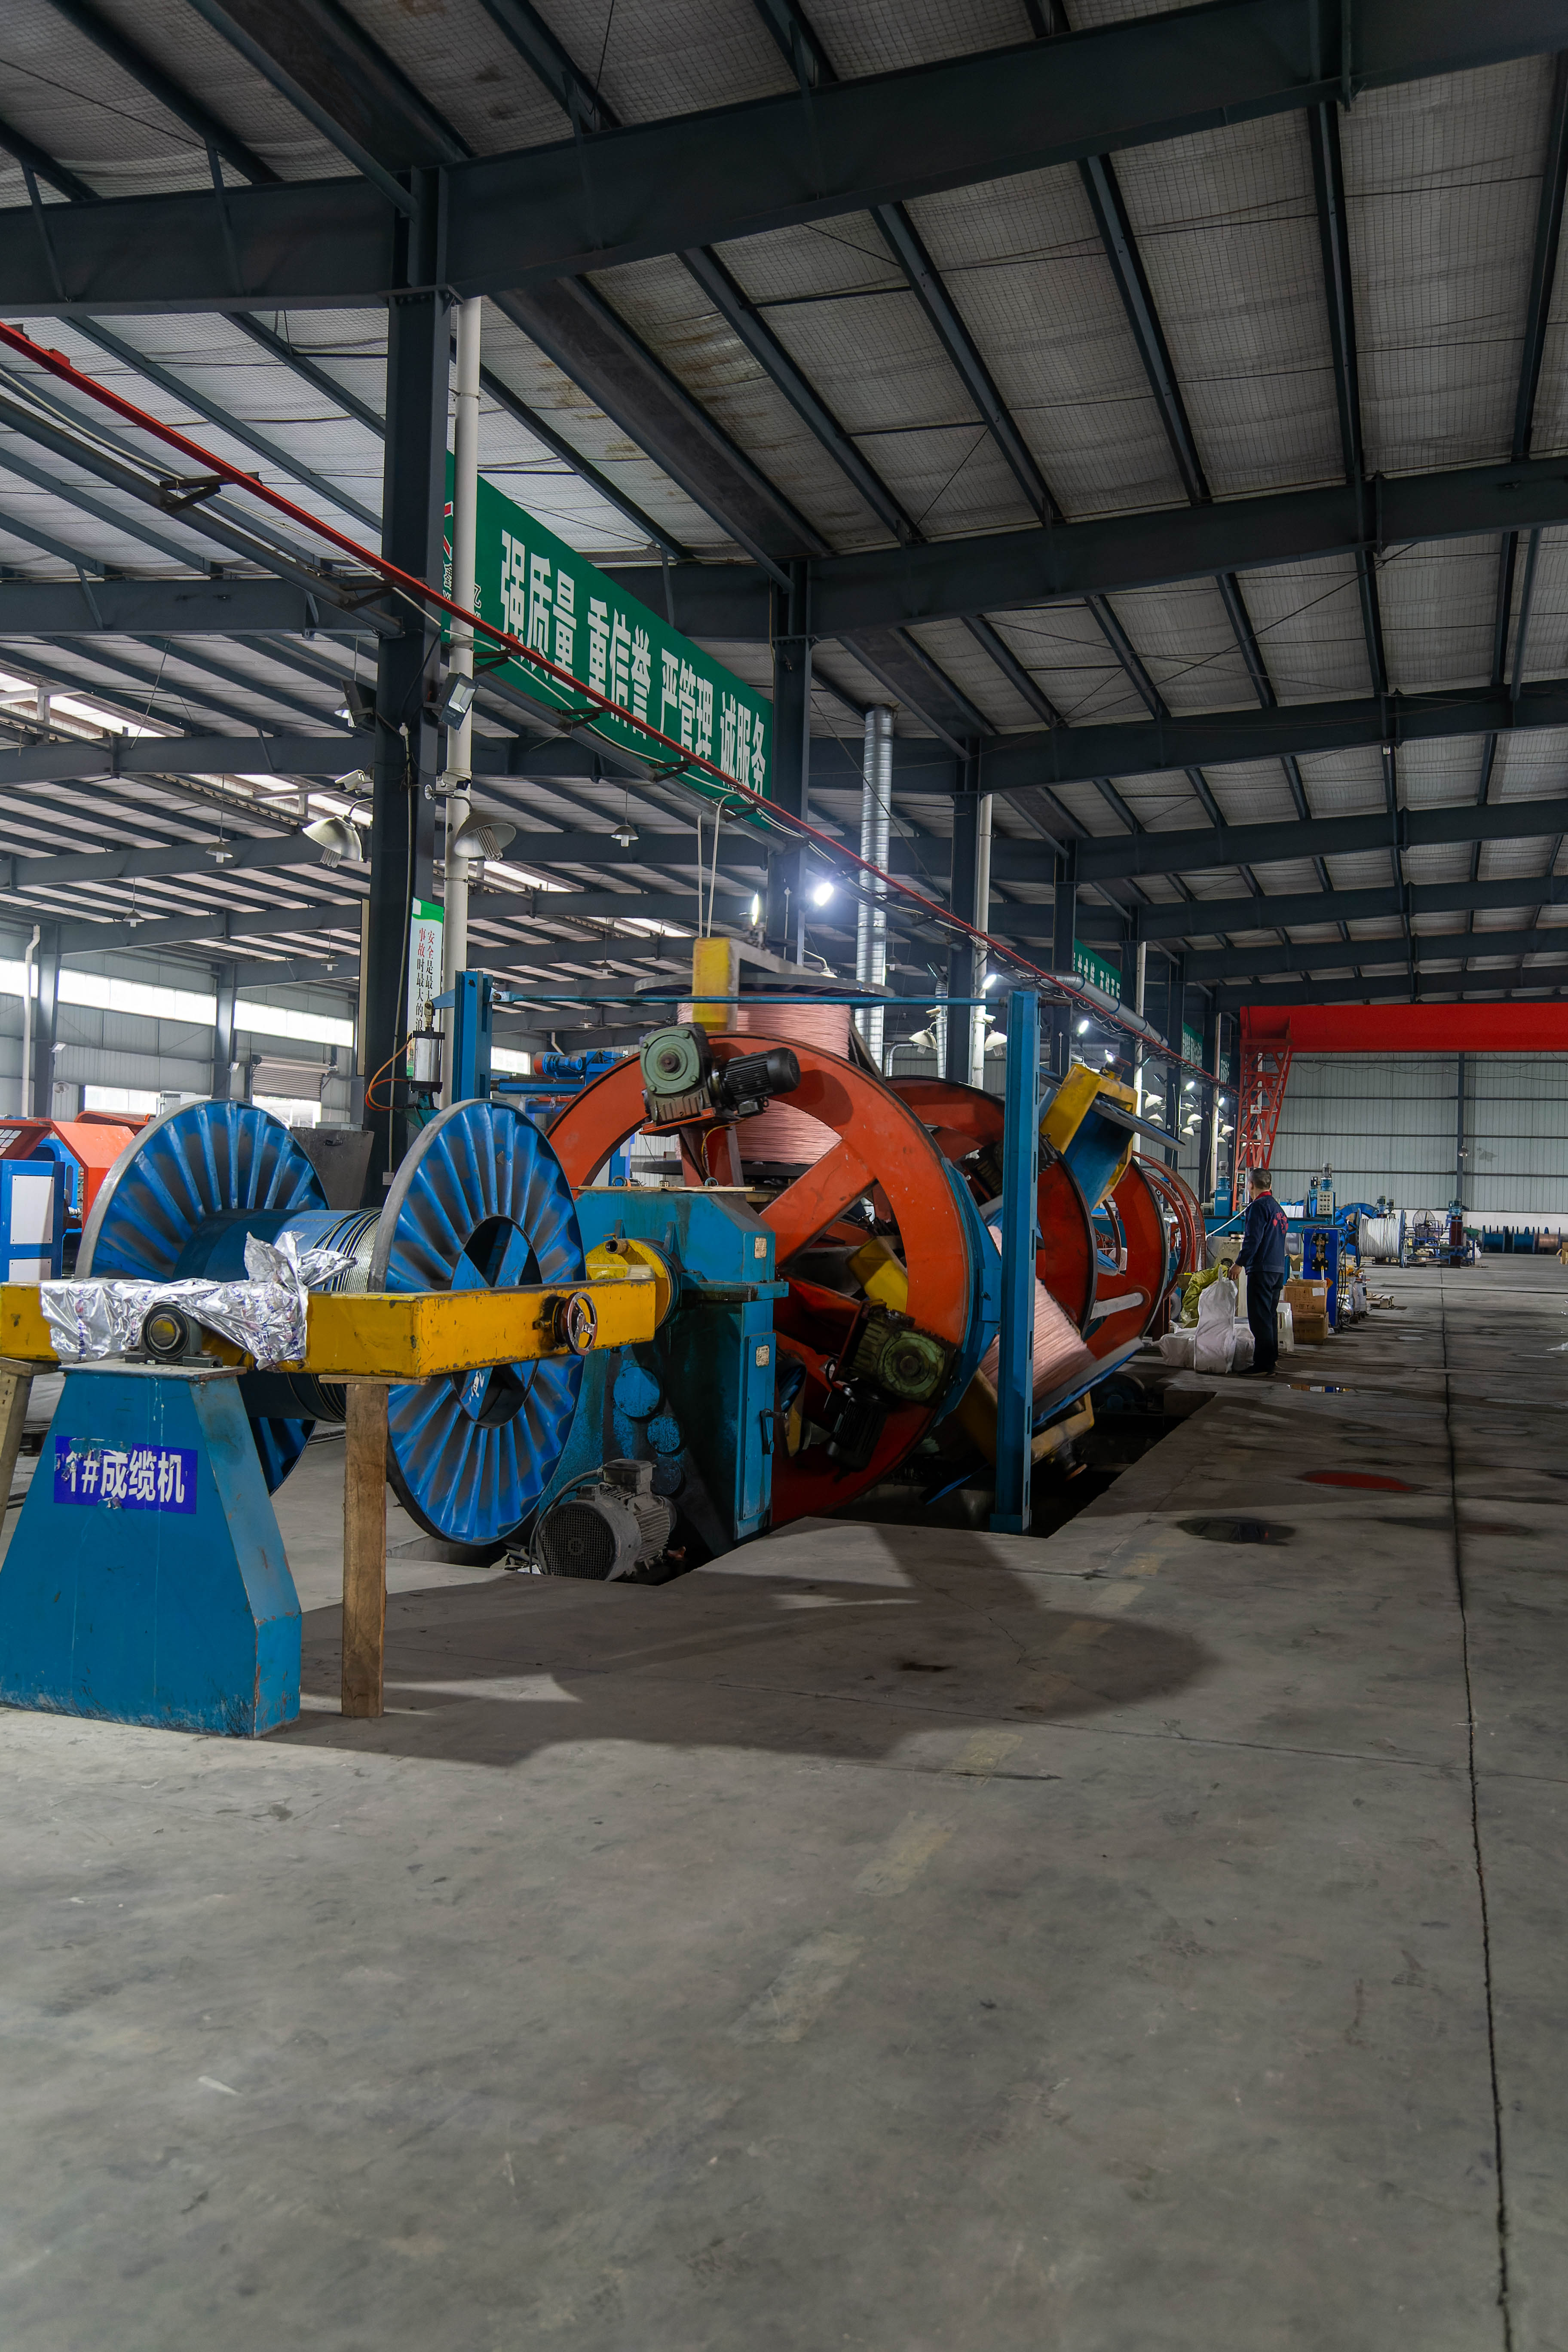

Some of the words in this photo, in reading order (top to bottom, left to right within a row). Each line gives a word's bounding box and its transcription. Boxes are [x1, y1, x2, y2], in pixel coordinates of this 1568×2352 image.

[500, 530, 576, 692] 强质量
[586, 597, 651, 740] 重信誉
[660, 648, 714, 775] 严管理
[720, 691, 766, 795] 诚服务
[426, 930, 435, 1001] 安全是最大
[66, 1449, 185, 1504] 1#成缆机
